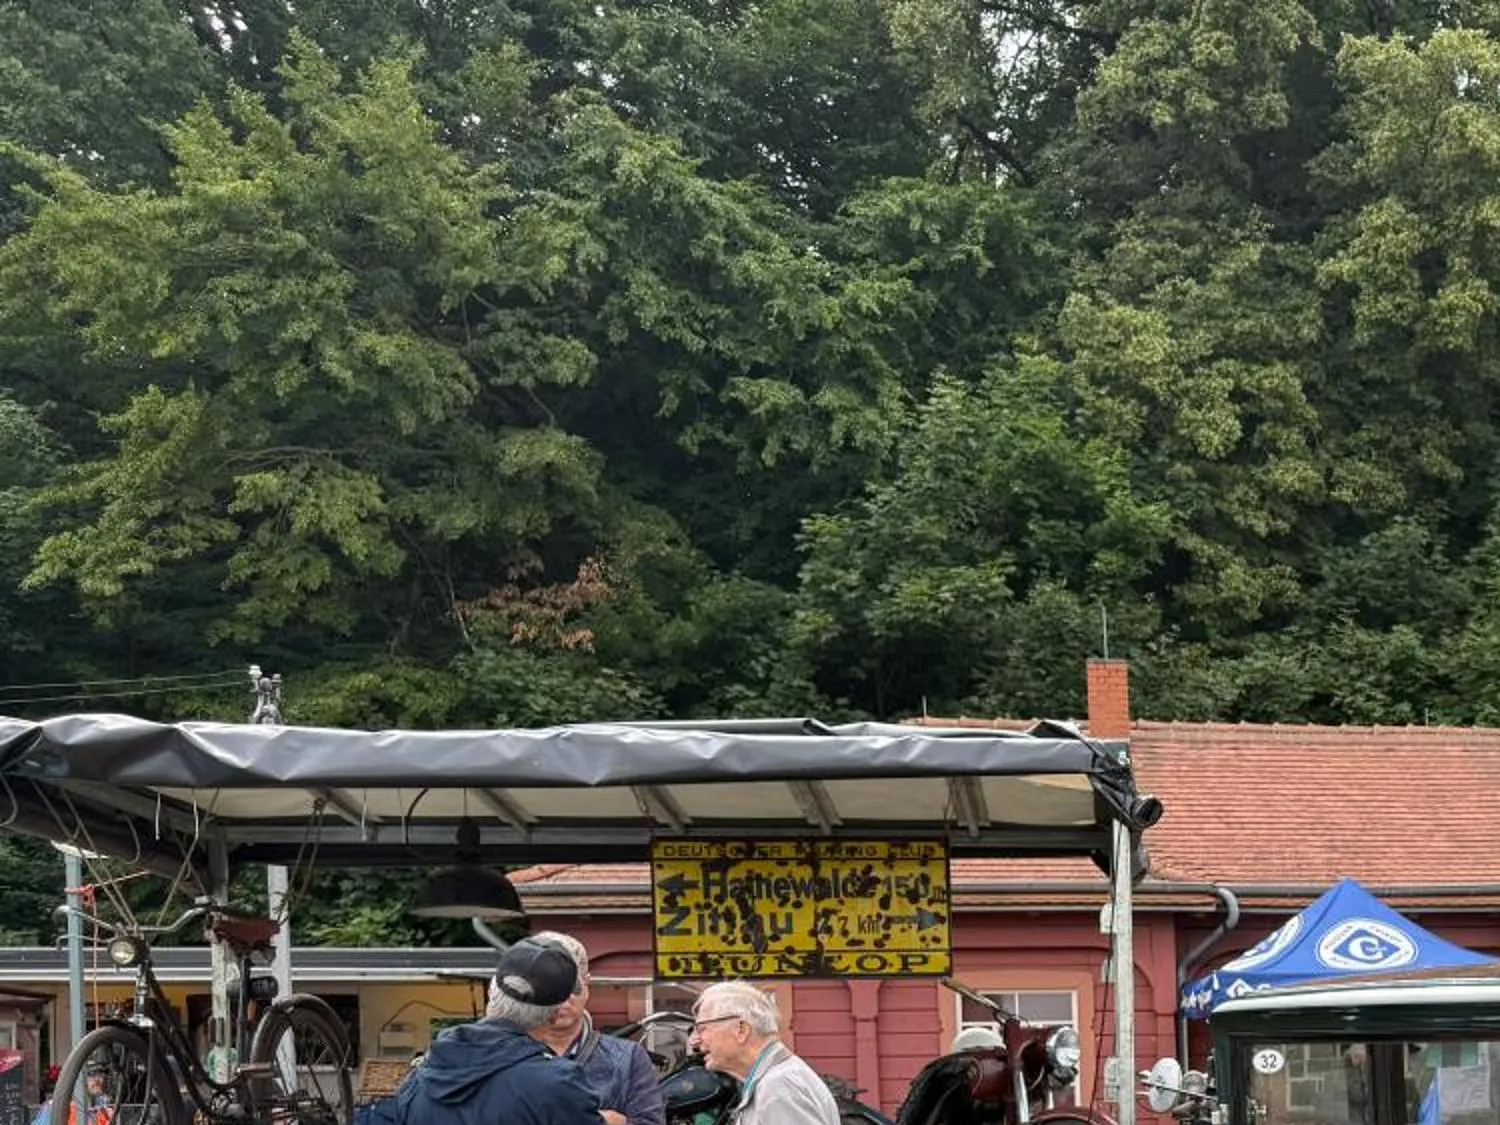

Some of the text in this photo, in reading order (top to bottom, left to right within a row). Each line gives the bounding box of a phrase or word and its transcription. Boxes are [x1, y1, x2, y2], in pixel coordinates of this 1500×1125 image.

[663, 845, 781, 858] DEUTSCER
[794, 845, 878, 857] TURING
[1260, 1053, 1278, 1069] 32
